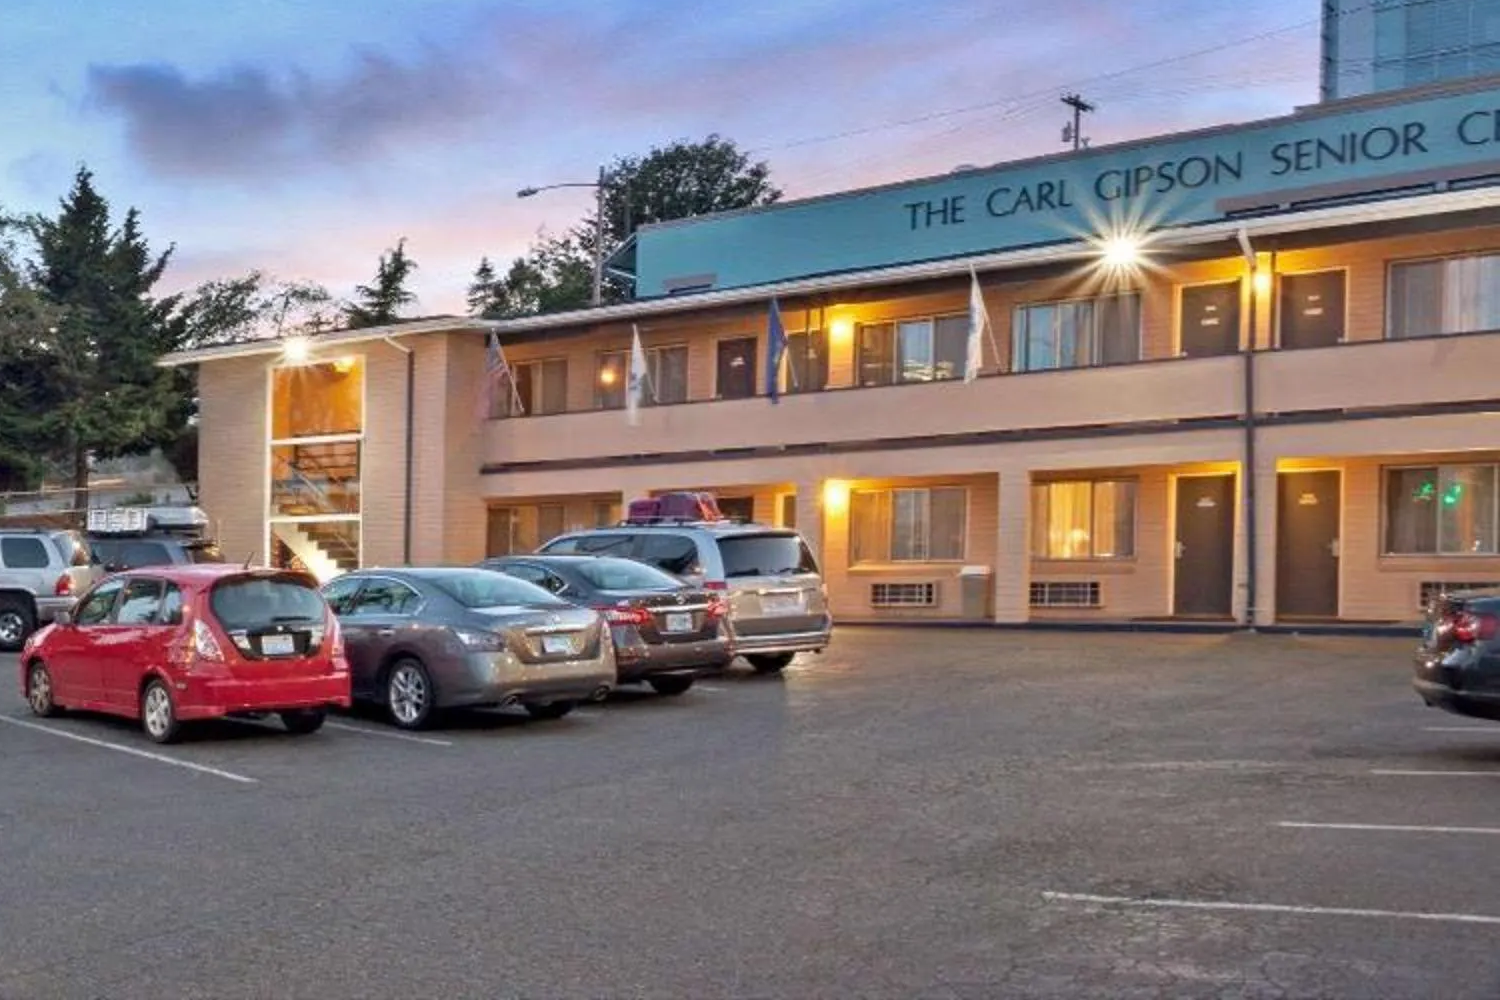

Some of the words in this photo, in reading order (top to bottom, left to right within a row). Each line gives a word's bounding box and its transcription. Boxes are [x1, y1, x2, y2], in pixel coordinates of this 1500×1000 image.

[905, 196, 965, 230] THE
[986, 179, 1072, 217] CARL
[1094, 151, 1242, 201] GIPSON
[1270, 121, 1429, 176] SENIOR
